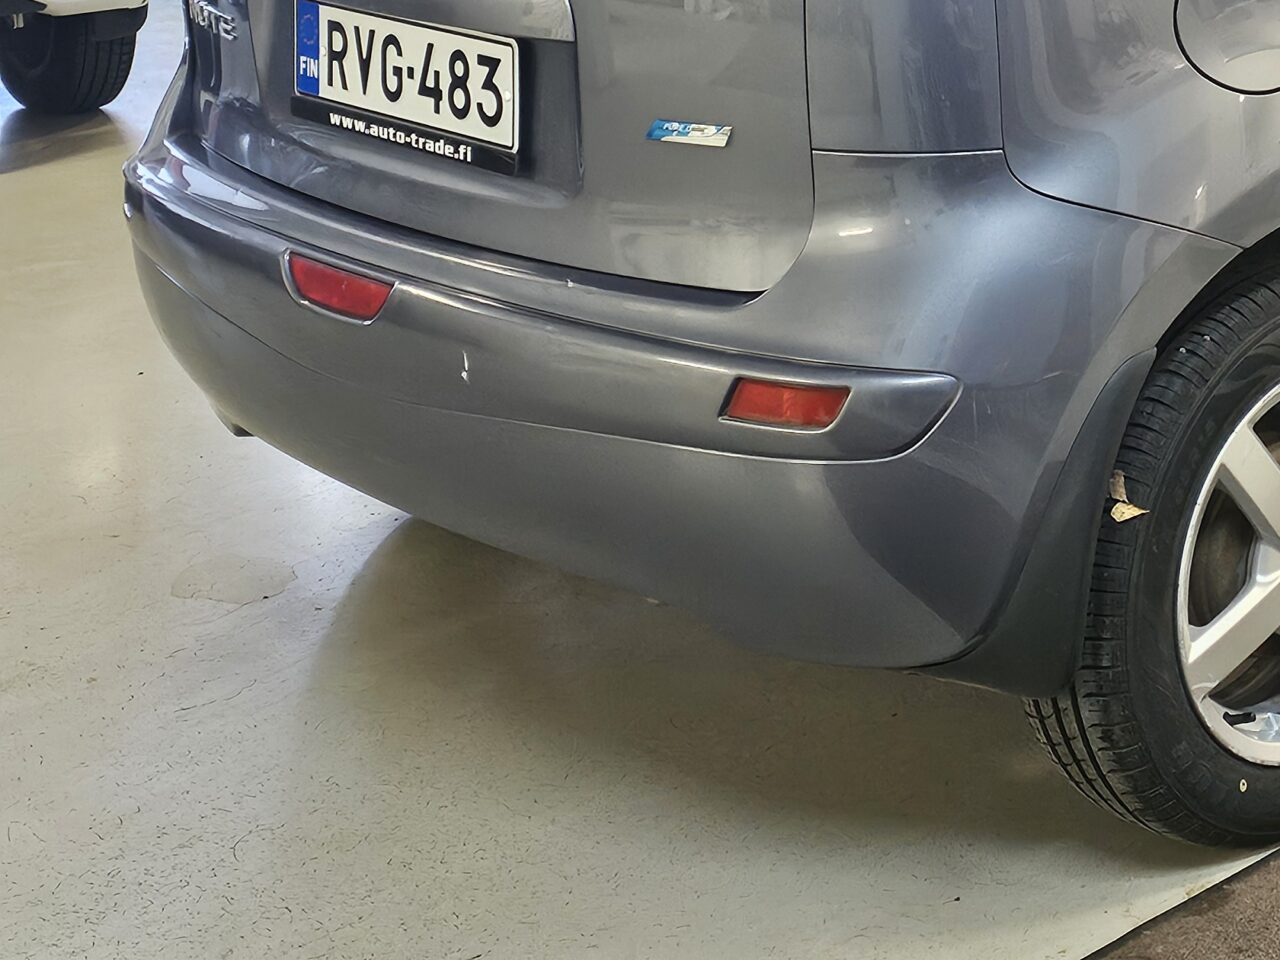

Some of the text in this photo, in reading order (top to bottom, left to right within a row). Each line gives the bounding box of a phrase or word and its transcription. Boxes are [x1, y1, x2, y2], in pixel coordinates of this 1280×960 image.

[300, 55, 319, 79] FIN
[326, 19, 504, 128] RVG-483
[329, 111, 472, 163] www.auto-trade.fi
